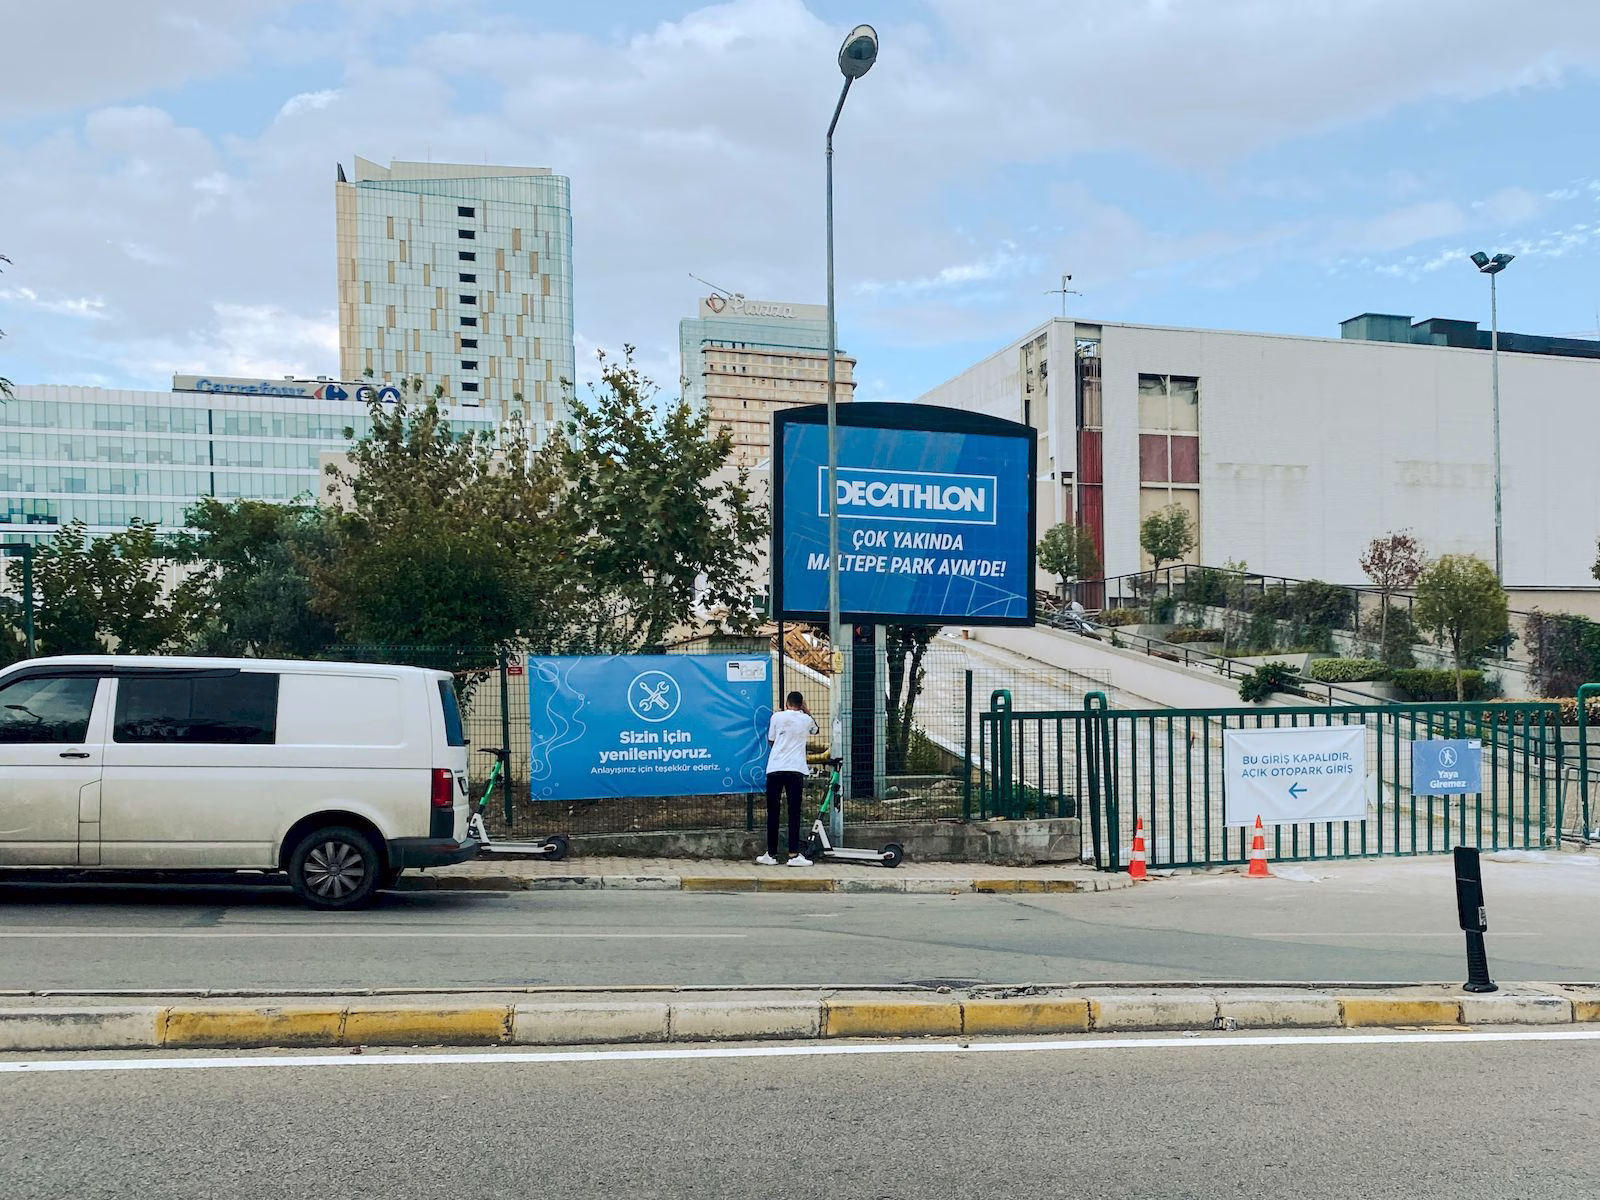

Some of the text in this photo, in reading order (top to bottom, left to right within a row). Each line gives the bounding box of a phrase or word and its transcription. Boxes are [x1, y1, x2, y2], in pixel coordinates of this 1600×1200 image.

[196, 379, 306, 396] Carrefour
[836, 480, 985, 512] DECATHLON
[852, 530, 964, 551] ÇOK YAKINDA
[890, 556, 935, 575] PARK
[937, 559, 1007, 577] AVM'DE!
[619, 729, 692, 745] Sizin için
[599, 747, 712, 764] yenileniyoruz.
[1242, 752, 1352, 765] BU GİRİŞ KAPALIDIR.
[590, 762, 720, 775] Anlayışınız için teşekkür ederiz.
[1241, 764, 1353, 778] AÇIK OTOPARK GİRİŞ
[1438, 770, 1459, 780] Yaya
[1430, 780, 1467, 788] Giremez
